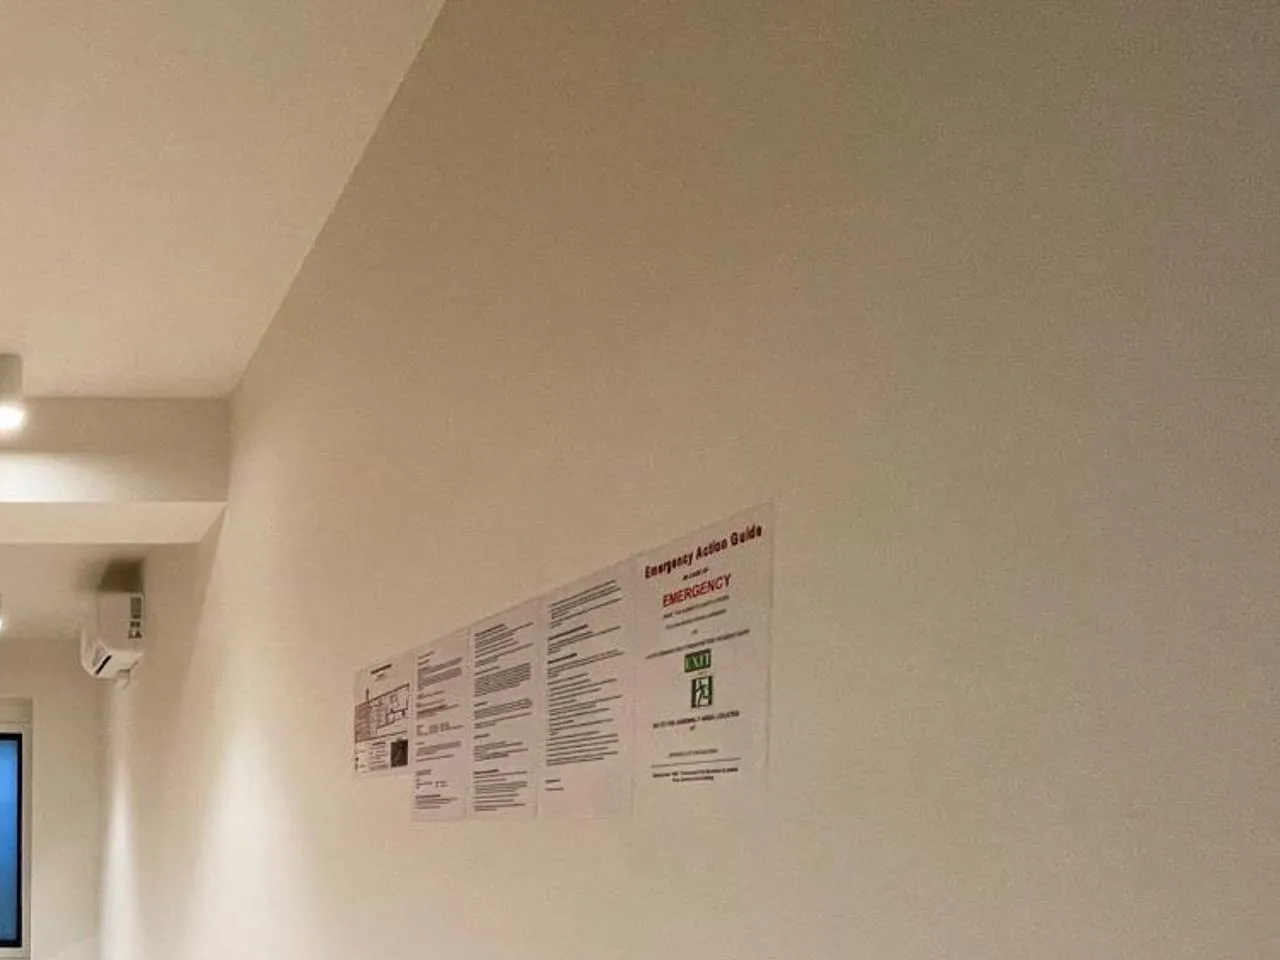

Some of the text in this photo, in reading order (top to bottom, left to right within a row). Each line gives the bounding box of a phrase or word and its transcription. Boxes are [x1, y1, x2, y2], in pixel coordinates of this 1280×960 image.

[645, 551, 694, 579] Emergency
[696, 538, 728, 560] Action
[730, 524, 762, 546] Guide
[663, 573, 732, 607] EMERGENCY
